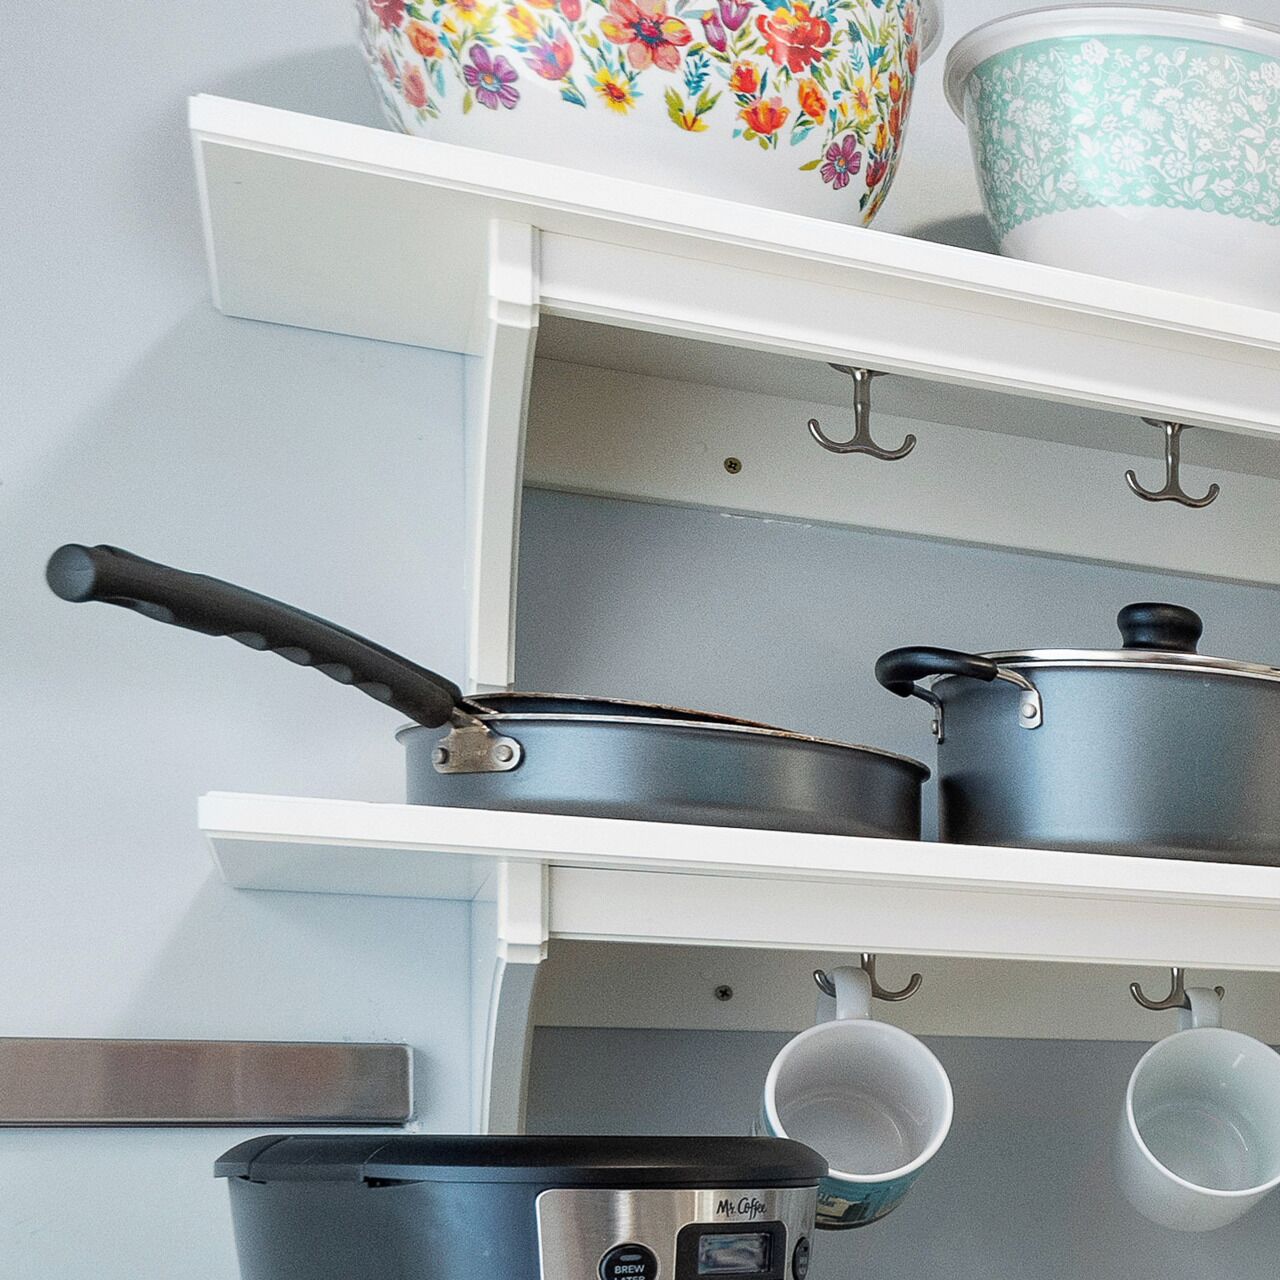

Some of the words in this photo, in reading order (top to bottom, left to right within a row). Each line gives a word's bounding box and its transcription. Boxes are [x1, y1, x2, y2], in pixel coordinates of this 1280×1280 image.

[716, 1199, 736, 1217] Mr.
[737, 1197, 767, 1220] Coffee
[614, 1265, 645, 1274] BREW
